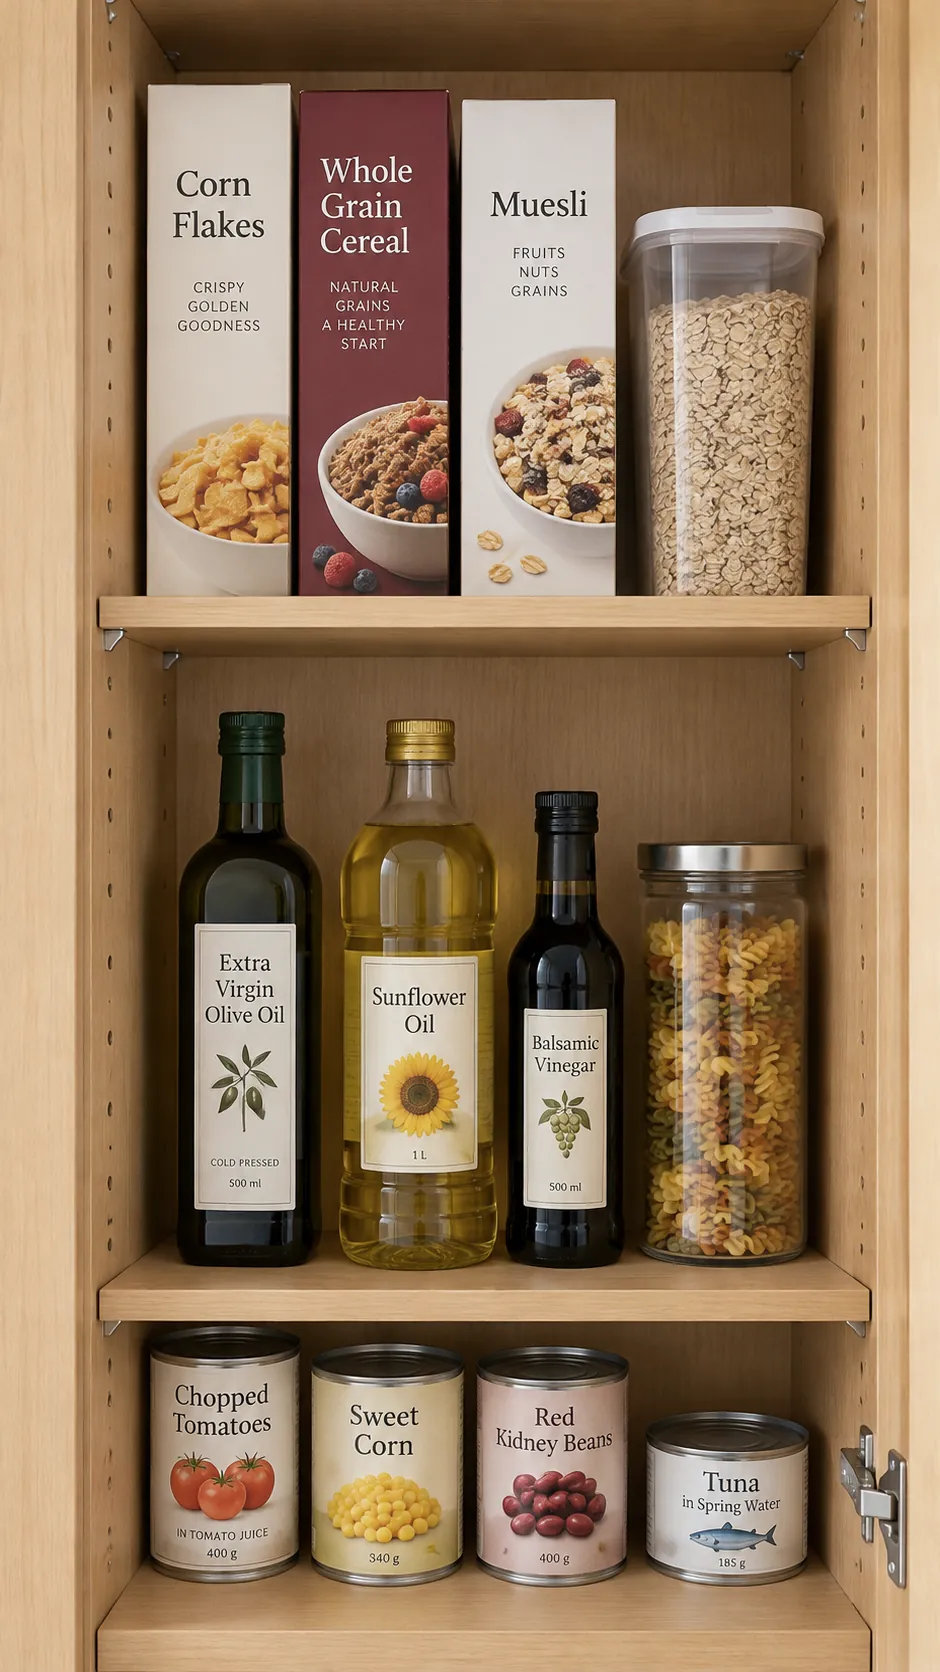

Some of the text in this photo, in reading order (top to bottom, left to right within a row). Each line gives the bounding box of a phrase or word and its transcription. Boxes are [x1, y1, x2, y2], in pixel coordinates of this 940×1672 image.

[320, 156, 412, 183] Whole
[177, 171, 251, 197] Corn
[322, 192, 402, 218] Grain
[491, 190, 587, 217] Muesli
[173, 211, 264, 238] Flakes
[321, 227, 409, 253] Cereal
[513, 247, 565, 259] FRUITS
[519, 266, 559, 278] NUTS
[193, 282, 245, 294] CRISPY
[330, 281, 399, 293] NATURAL
[510, 285, 568, 297] GRAINS
[187, 301, 249, 313] GOLDEN
[335, 300, 390, 312] GRAINS
[177, 320, 260, 332] GOODNESS
[321, 319, 405, 331] A HEALTHY
[341, 338, 387, 350] START
[220, 954, 270, 971] Extra
[216, 980, 274, 1002] Virgin
[373, 987, 466, 1006] Sunflower
[206, 1006, 284, 1023] Olive Oil
[405, 1014, 434, 1033] Oil
[533, 1035, 599, 1050] Balsamic
[535, 1057, 596, 1076] Vinegar
[413, 1150, 427, 1160] 1 L
[210, 1159, 280, 1168] COLD PRESSED
[229, 1179, 262, 1188] 500 ml
[549, 1183, 582, 1192] 500 ml
[174, 1383, 269, 1413] Chopped
[351, 1405, 419, 1426] Sweet
[536, 1407, 574, 1426] Red
[172, 1412, 272, 1436] Tomatoes
[355, 1434, 413, 1455] Corn
[497, 1428, 613, 1457] Kidney Beans
[703, 1471, 760, 1492] Tuna
[683, 1495, 780, 1516] in Spring Water
[176, 1528, 268, 1541] IN TOMATO JUICE
[206, 1548, 238, 1561] 400 g
[369, 1553, 400, 1567] 340 g
[539, 1553, 570, 1566] 400 g
[719, 1558, 746, 1570] 185 g
